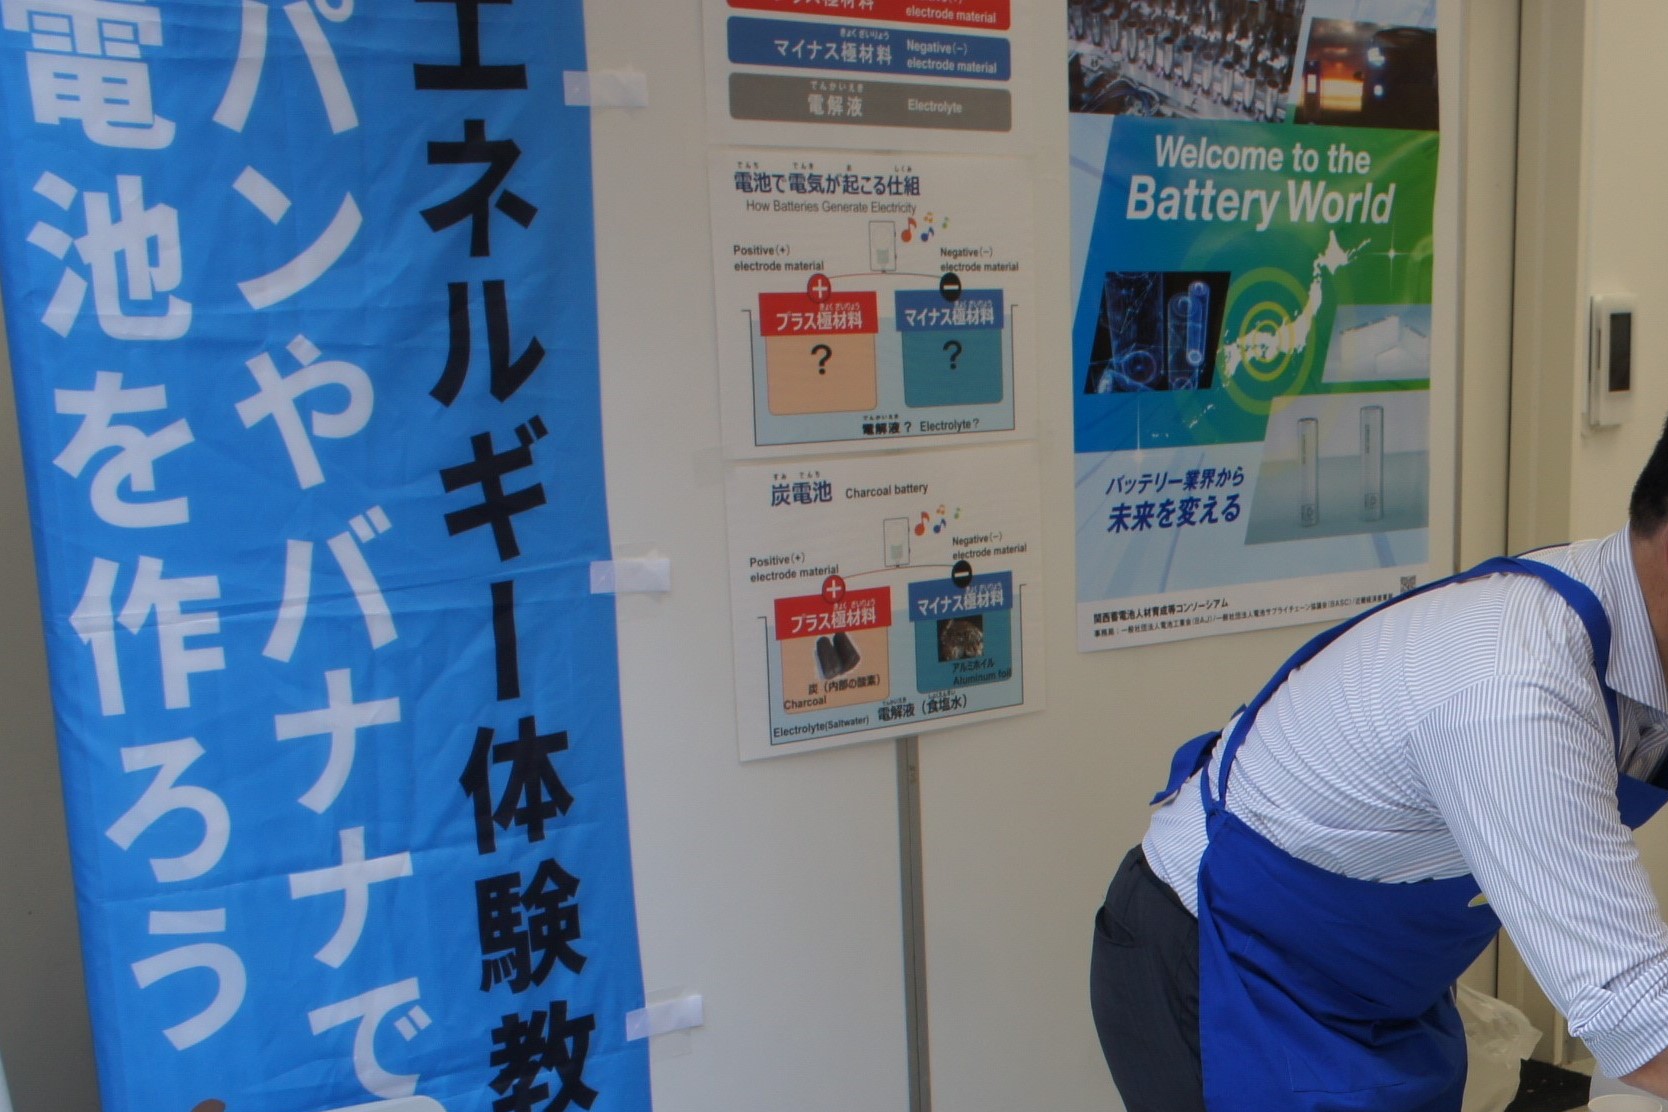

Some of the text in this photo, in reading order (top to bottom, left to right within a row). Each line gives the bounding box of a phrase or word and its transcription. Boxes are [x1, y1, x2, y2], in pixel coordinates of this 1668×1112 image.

[906, 5, 997, 24] electrode material
[774, 38, 893, 66] マイナス極材料
[907, 57, 997, 75] electrode material
[808, 93, 863, 118] 電解液
[908, 99, 963, 115] Electrolyte
[1155, 134, 1371, 174] Welcome to the
[733, 171, 921, 197] 電池で電気が起こる仕組
[746, 200, 917, 216] How Batteries Generate Electricity
[1126, 174, 1396, 232] Battery World
[734, 260, 824, 271] electrode material
[940, 260, 1019, 272] electrode material
[776, 310, 863, 331] プラス極材料
[904, 307, 994, 327] マイナス極材料
[1105, 466, 1245, 496] バッテリー業界から
[771, 480, 833, 507] 炭電池
[845, 483, 929, 500] Charcoal battery
[1107, 493, 1242, 534] 未来を変える
[2, 0, 246, 1051] 電池を作ろう
[211, 0, 433, 1098] パンやバナナで
[952, 543, 1027, 560] electrode material
[750, 564, 839, 584] electrode material
[917, 590, 1004, 616] マイナス極材料
[791, 607, 877, 634] プラス極材料
[952, 658, 994, 675] アルミホイル
[953, 671, 996, 686] Aluminum
[783, 695, 827, 711] Charcoal
